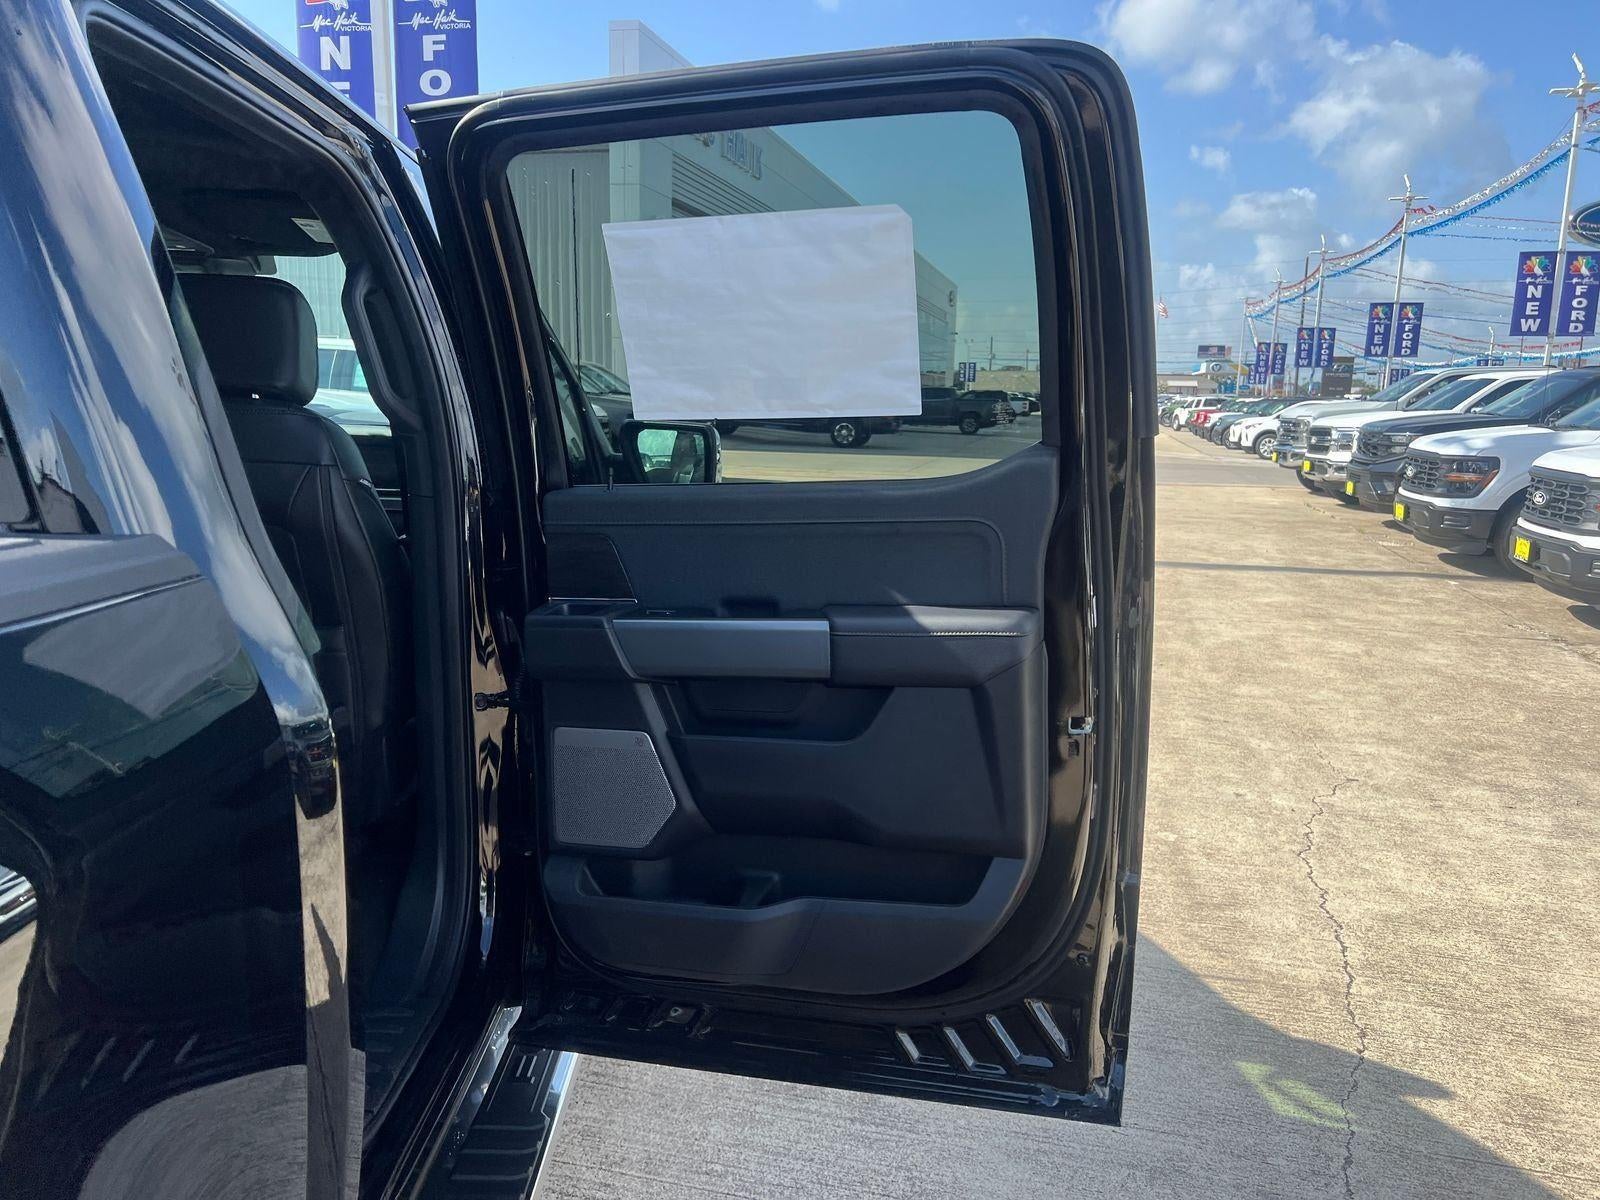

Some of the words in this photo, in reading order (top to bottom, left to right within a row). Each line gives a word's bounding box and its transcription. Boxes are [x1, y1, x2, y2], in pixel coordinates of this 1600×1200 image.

[1520, 285, 1543, 332] NEW
[1568, 285, 1588, 333] FORD
[1299, 343, 1309, 366] NEW
[1320, 342, 1329, 366] FORD
[1370, 324, 1384, 355] NEW
[1401, 324, 1413, 356] FORD
[1258, 355, 1266, 373] NEW
